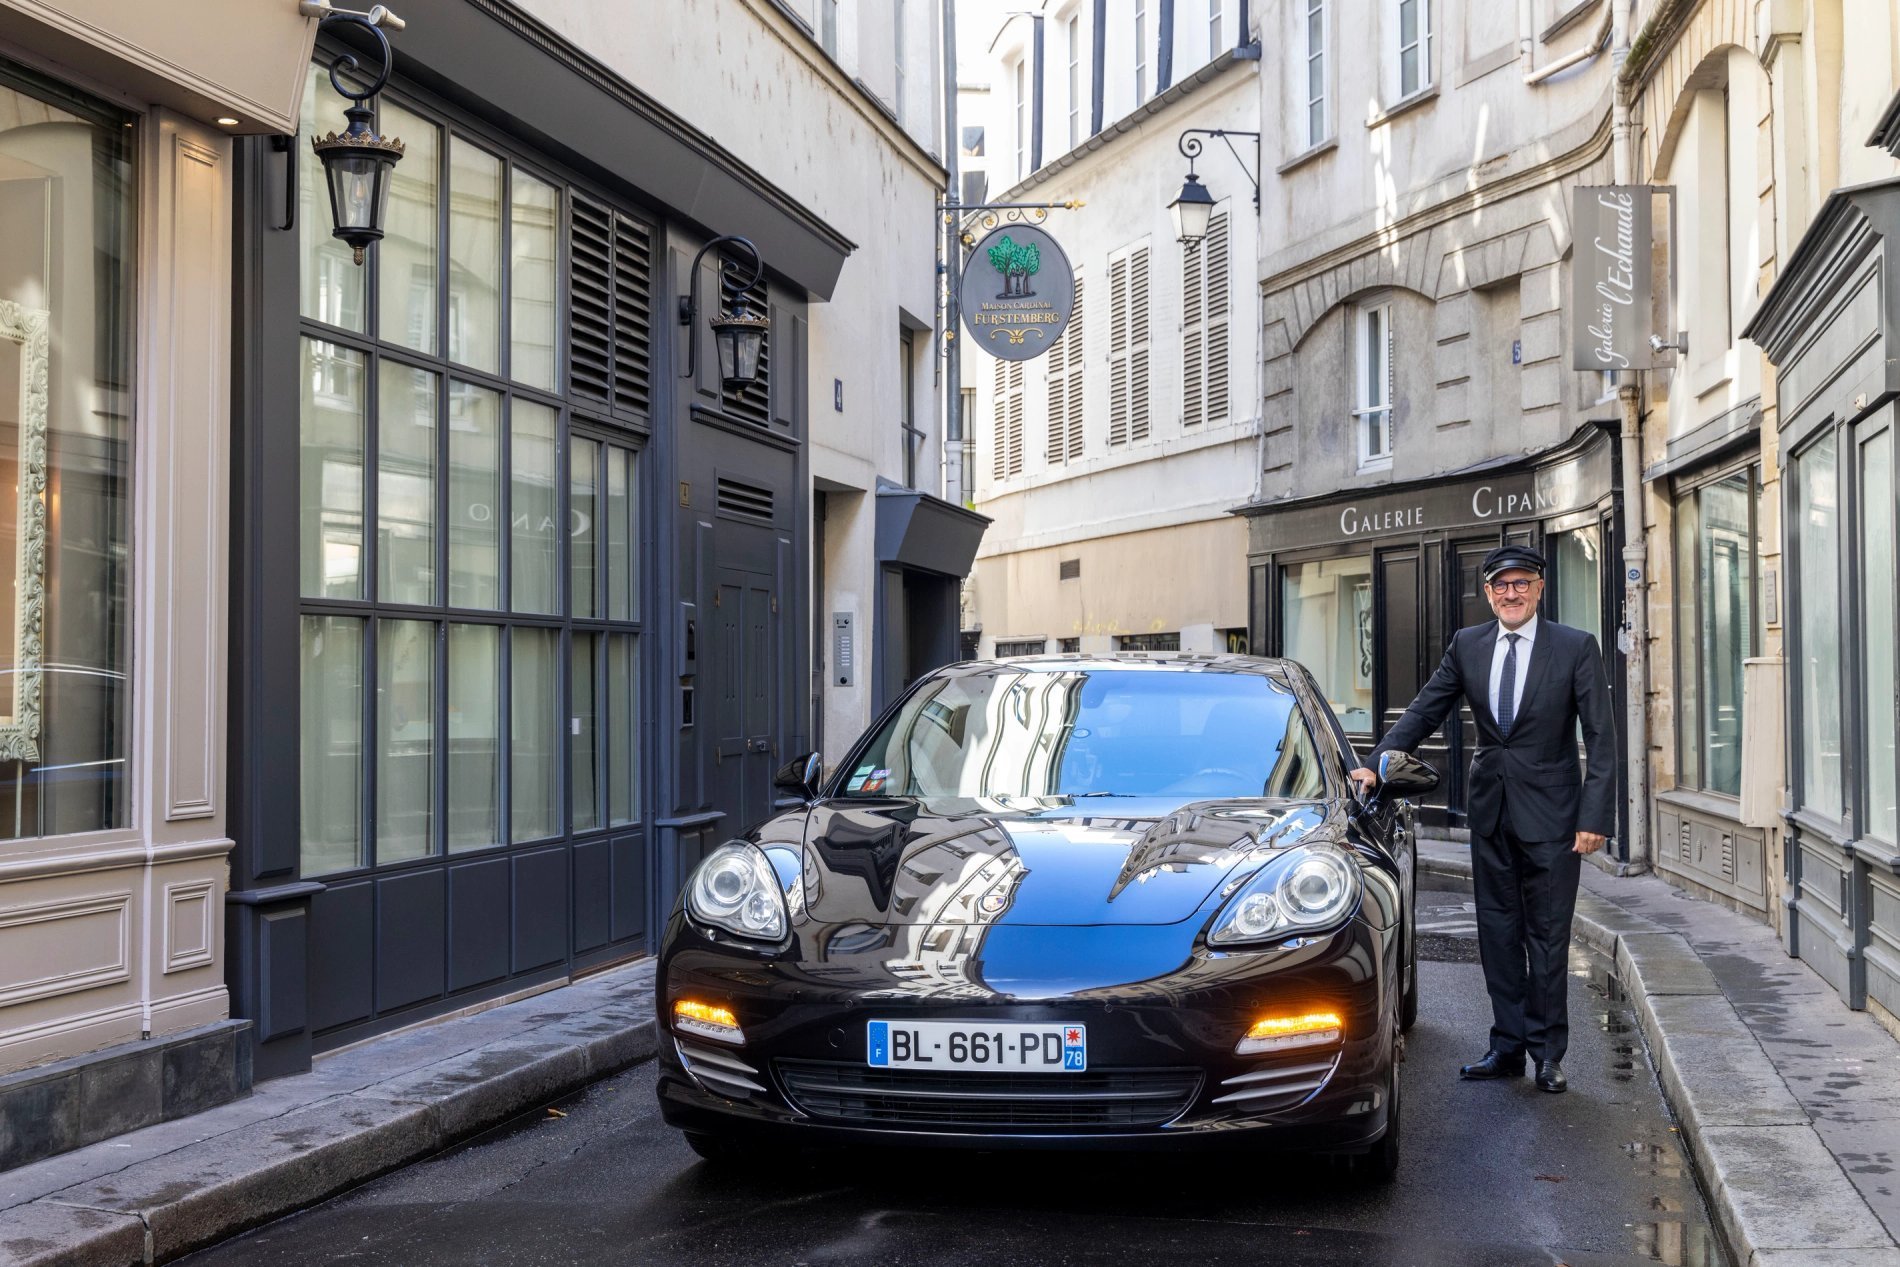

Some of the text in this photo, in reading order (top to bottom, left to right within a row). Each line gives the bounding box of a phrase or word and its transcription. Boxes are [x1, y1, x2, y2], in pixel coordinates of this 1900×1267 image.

[981, 302, 1052, 311] MAISON CARDINAL
[974, 312, 1060, 325] FURSTEMBERG
[1587, 302, 1630, 369] Galerie
[1514, 343, 1521, 361] 5
[1340, 507, 1424, 536] GALERIE
[875, 1048, 882, 1058] F
[892, 1030, 1063, 1065] BL-661-PD
[1066, 1051, 1083, 1067] 78
